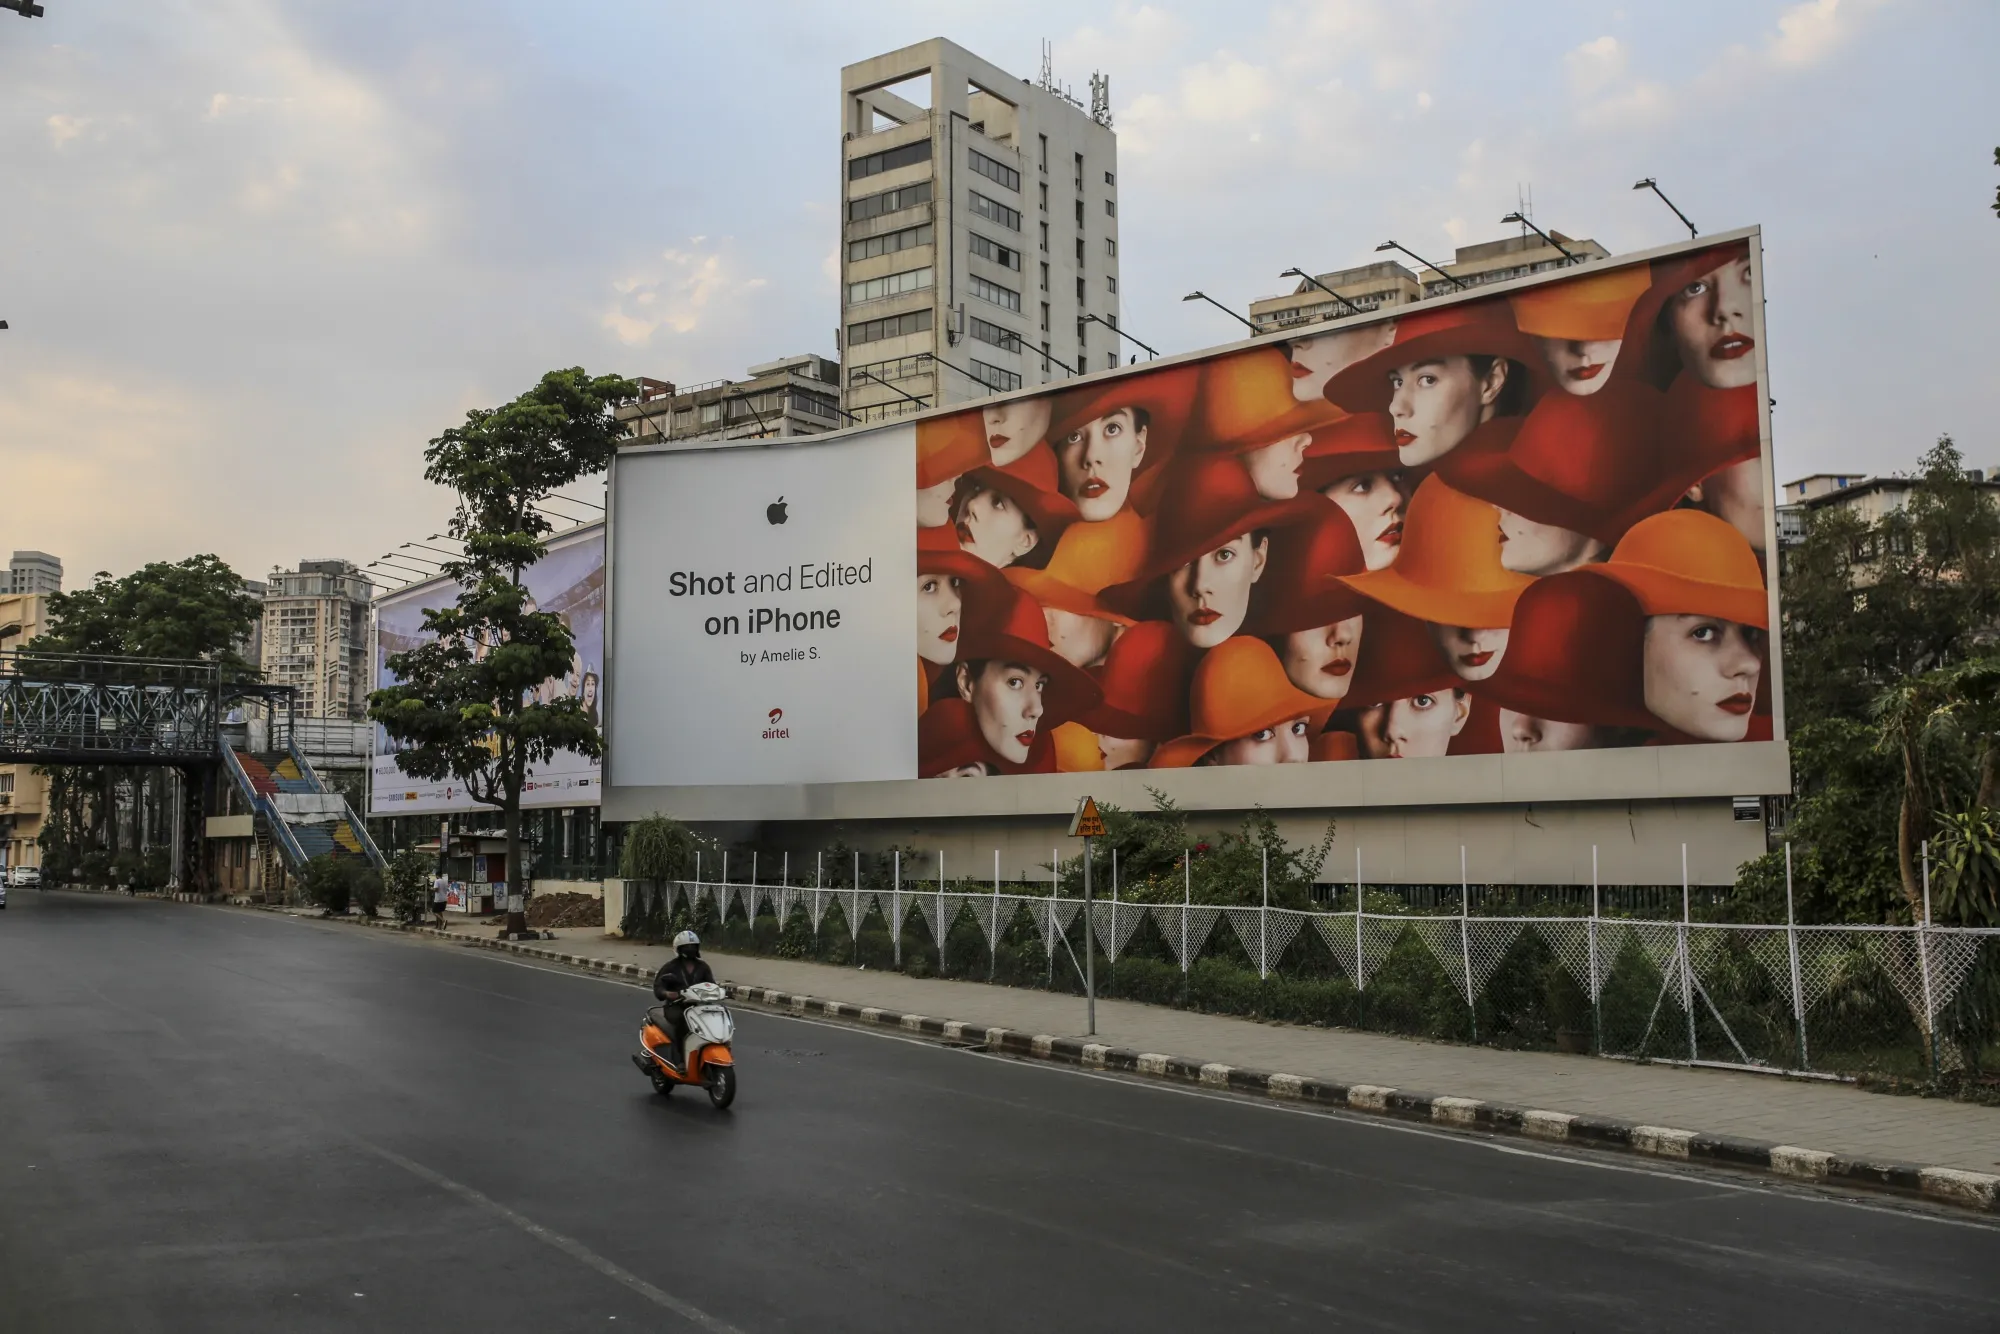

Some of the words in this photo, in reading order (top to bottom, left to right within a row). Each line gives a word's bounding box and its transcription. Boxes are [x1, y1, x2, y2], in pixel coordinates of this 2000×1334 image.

[669, 571, 736, 597] Shot
[743, 566, 792, 594] and
[800, 557, 872, 590] Edited
[704, 615, 739, 636] on
[748, 608, 841, 634] iPhone
[740, 650, 757, 666] by
[760, 648, 806, 663] Amelie
[808, 646, 821, 660] S.
[761, 727, 790, 740] airtel
[388, 793, 405, 802] SAMSUNG
